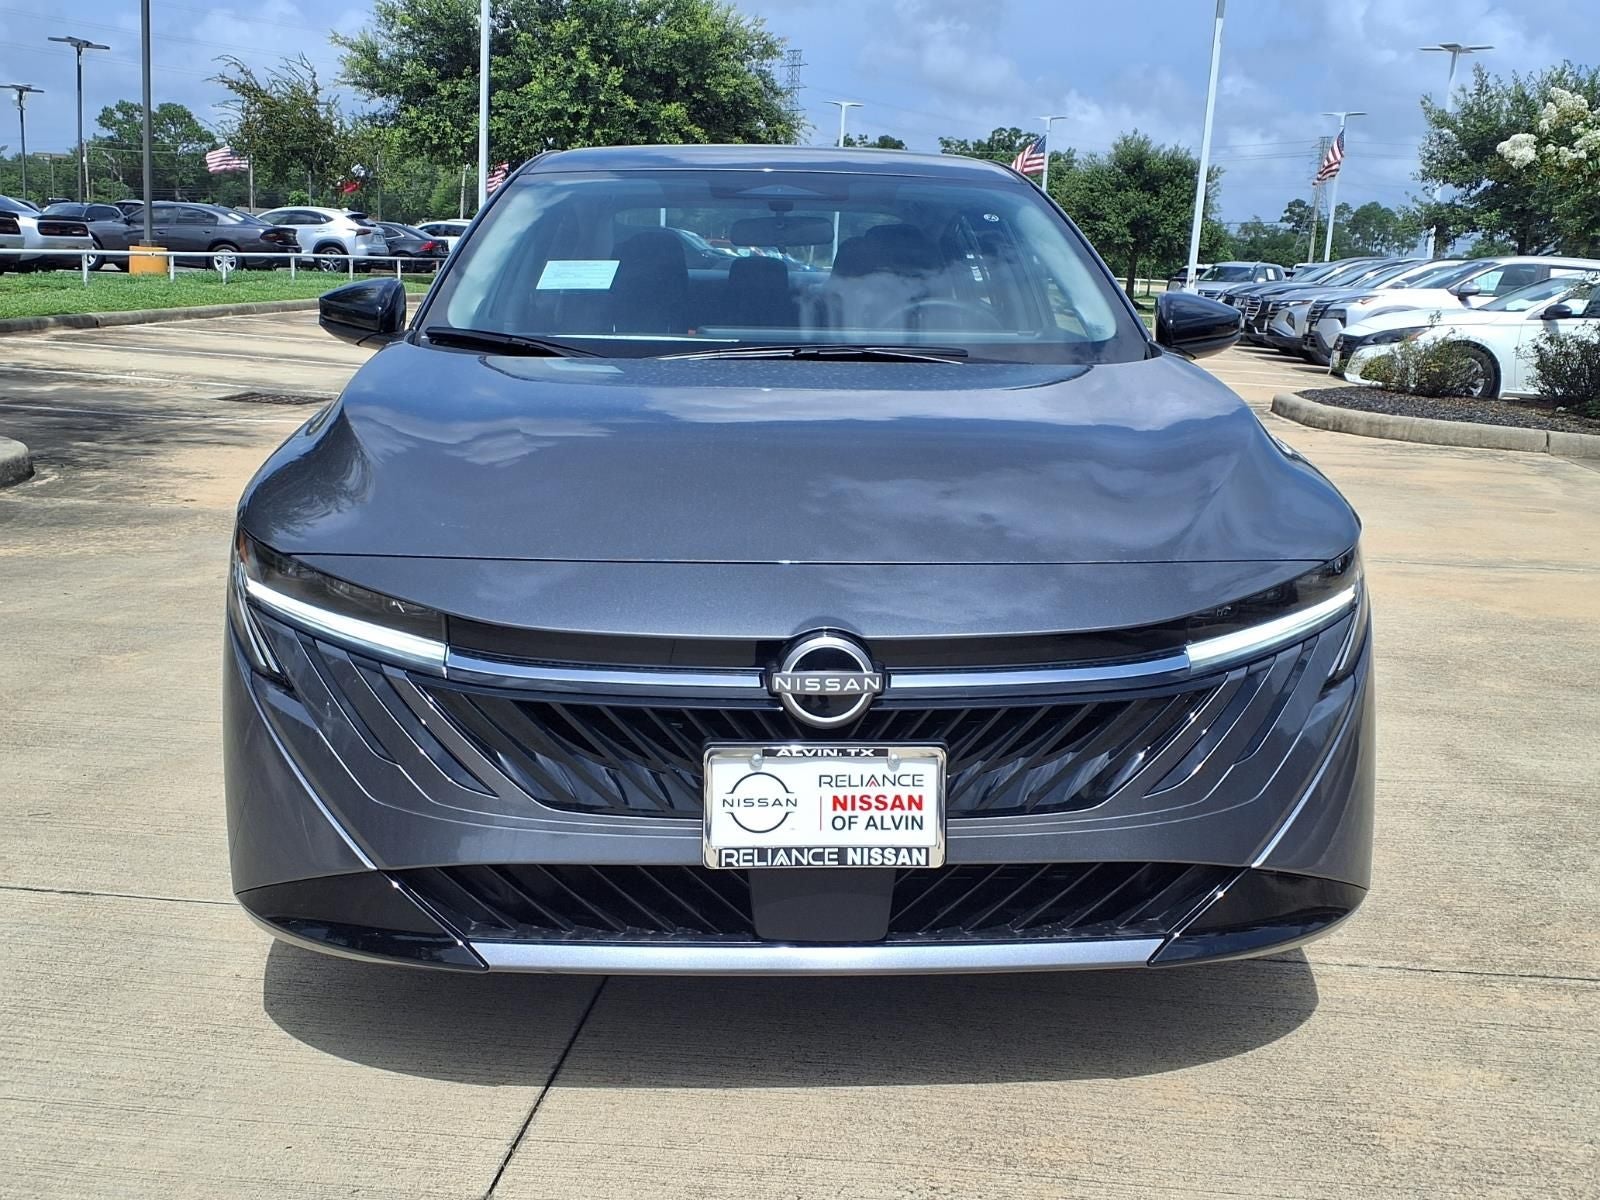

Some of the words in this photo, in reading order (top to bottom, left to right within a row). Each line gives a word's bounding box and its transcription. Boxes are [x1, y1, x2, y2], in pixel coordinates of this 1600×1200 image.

[774, 677, 881, 692] NISSAN
[846, 748, 875, 757] TX
[818, 774, 924, 788] RELIANCE
[722, 798, 798, 807] NISSAN
[832, 794, 924, 812] NISSAN
[831, 815, 859, 831] OF
[864, 815, 924, 831] ALVIN
[721, 849, 839, 866] RELIANCE
[847, 848, 927, 866] NISSAN
